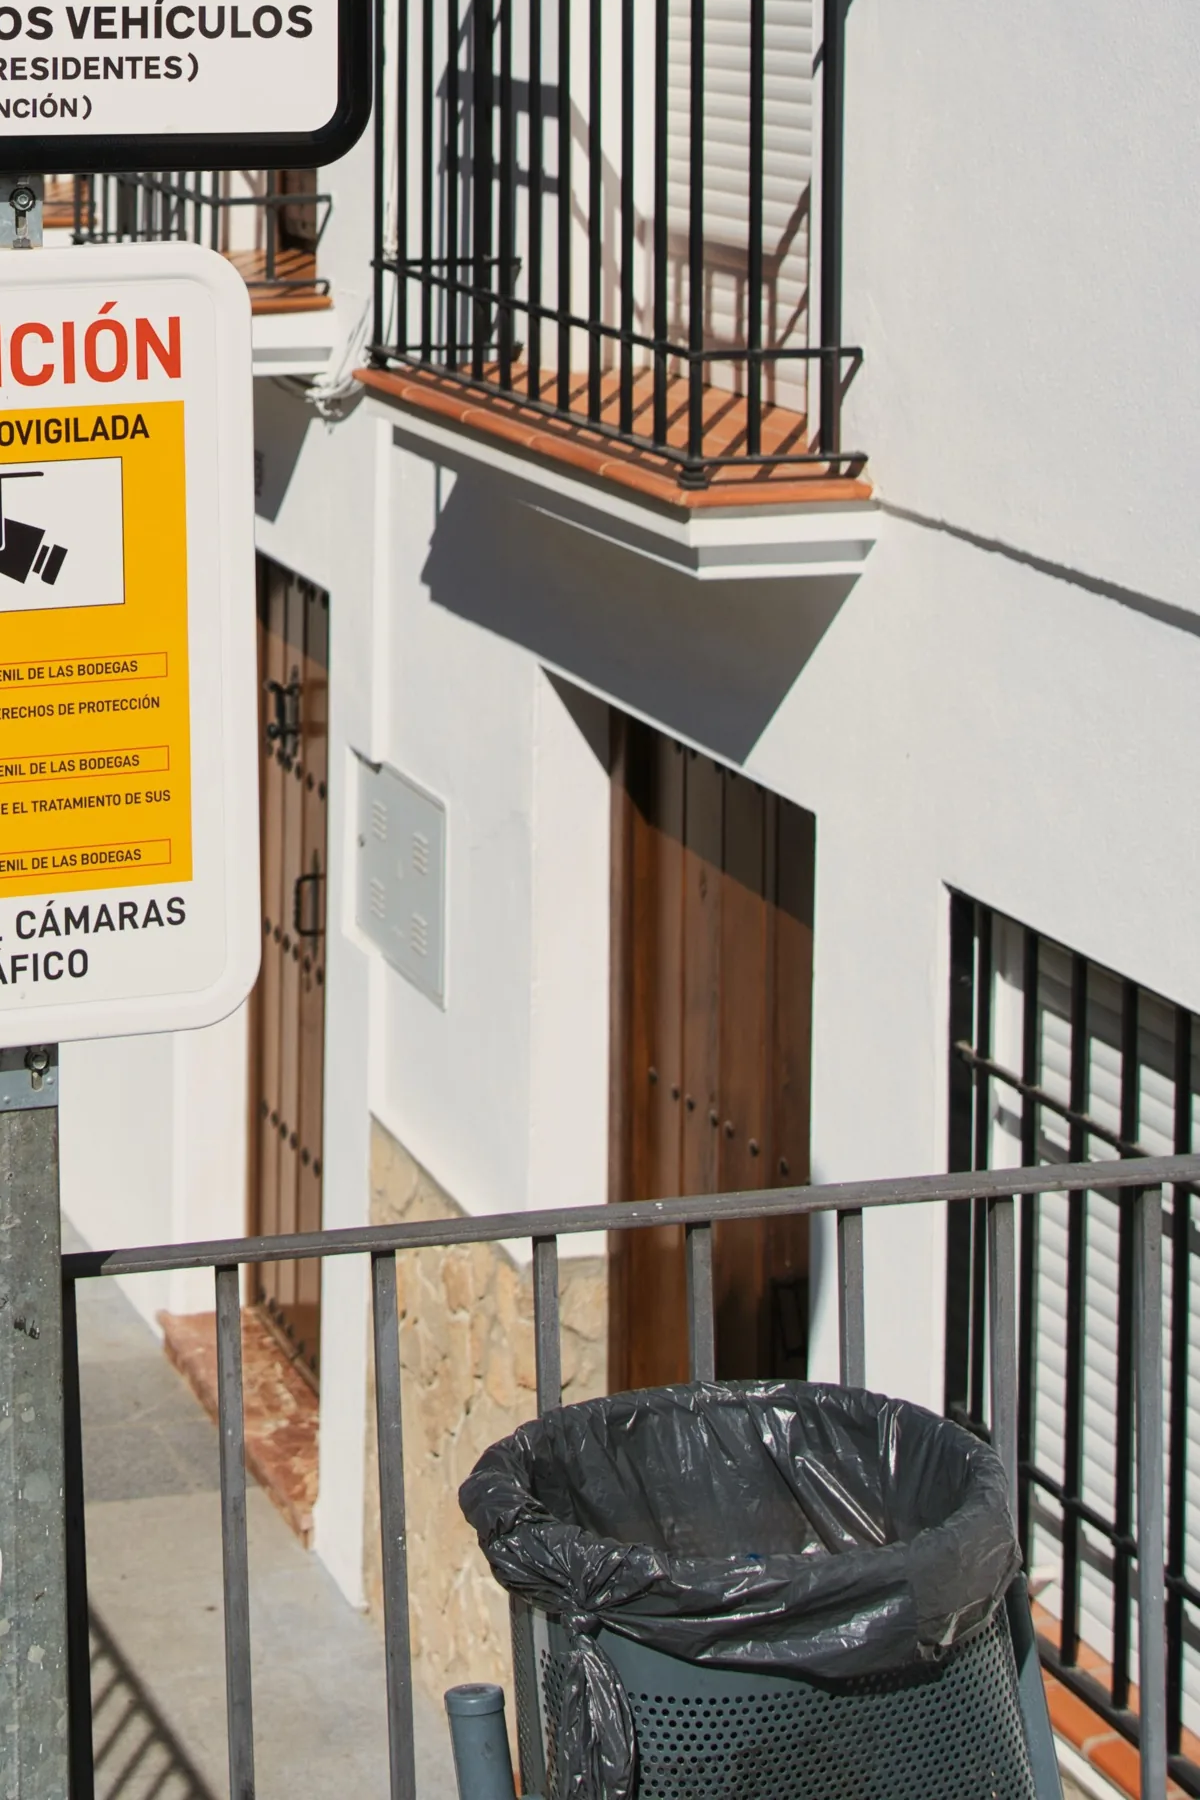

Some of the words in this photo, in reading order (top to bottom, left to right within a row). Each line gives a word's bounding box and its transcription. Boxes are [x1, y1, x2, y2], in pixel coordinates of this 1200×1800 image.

[27, 666, 45, 680] DE
[48, 664, 74, 679] LAS
[77, 660, 138, 677] BODEGAS
[58, 702, 75, 716] DE
[78, 696, 160, 715] PROTECCIÓN
[29, 761, 47, 775] DE
[50, 759, 76, 774] LAS
[79, 754, 140, 771] BODEGAS
[12, 801, 29, 815] EL
[31, 793, 122, 813] TRATAMIENTO
[124, 791, 142, 806] DE
[145, 789, 171, 804] SUS
[31, 856, 49, 870] DE
[51, 854, 78, 868] LAS
[80, 848, 142, 866] BODEGAS
[15, 896, 186, 940] CÁMARAS
